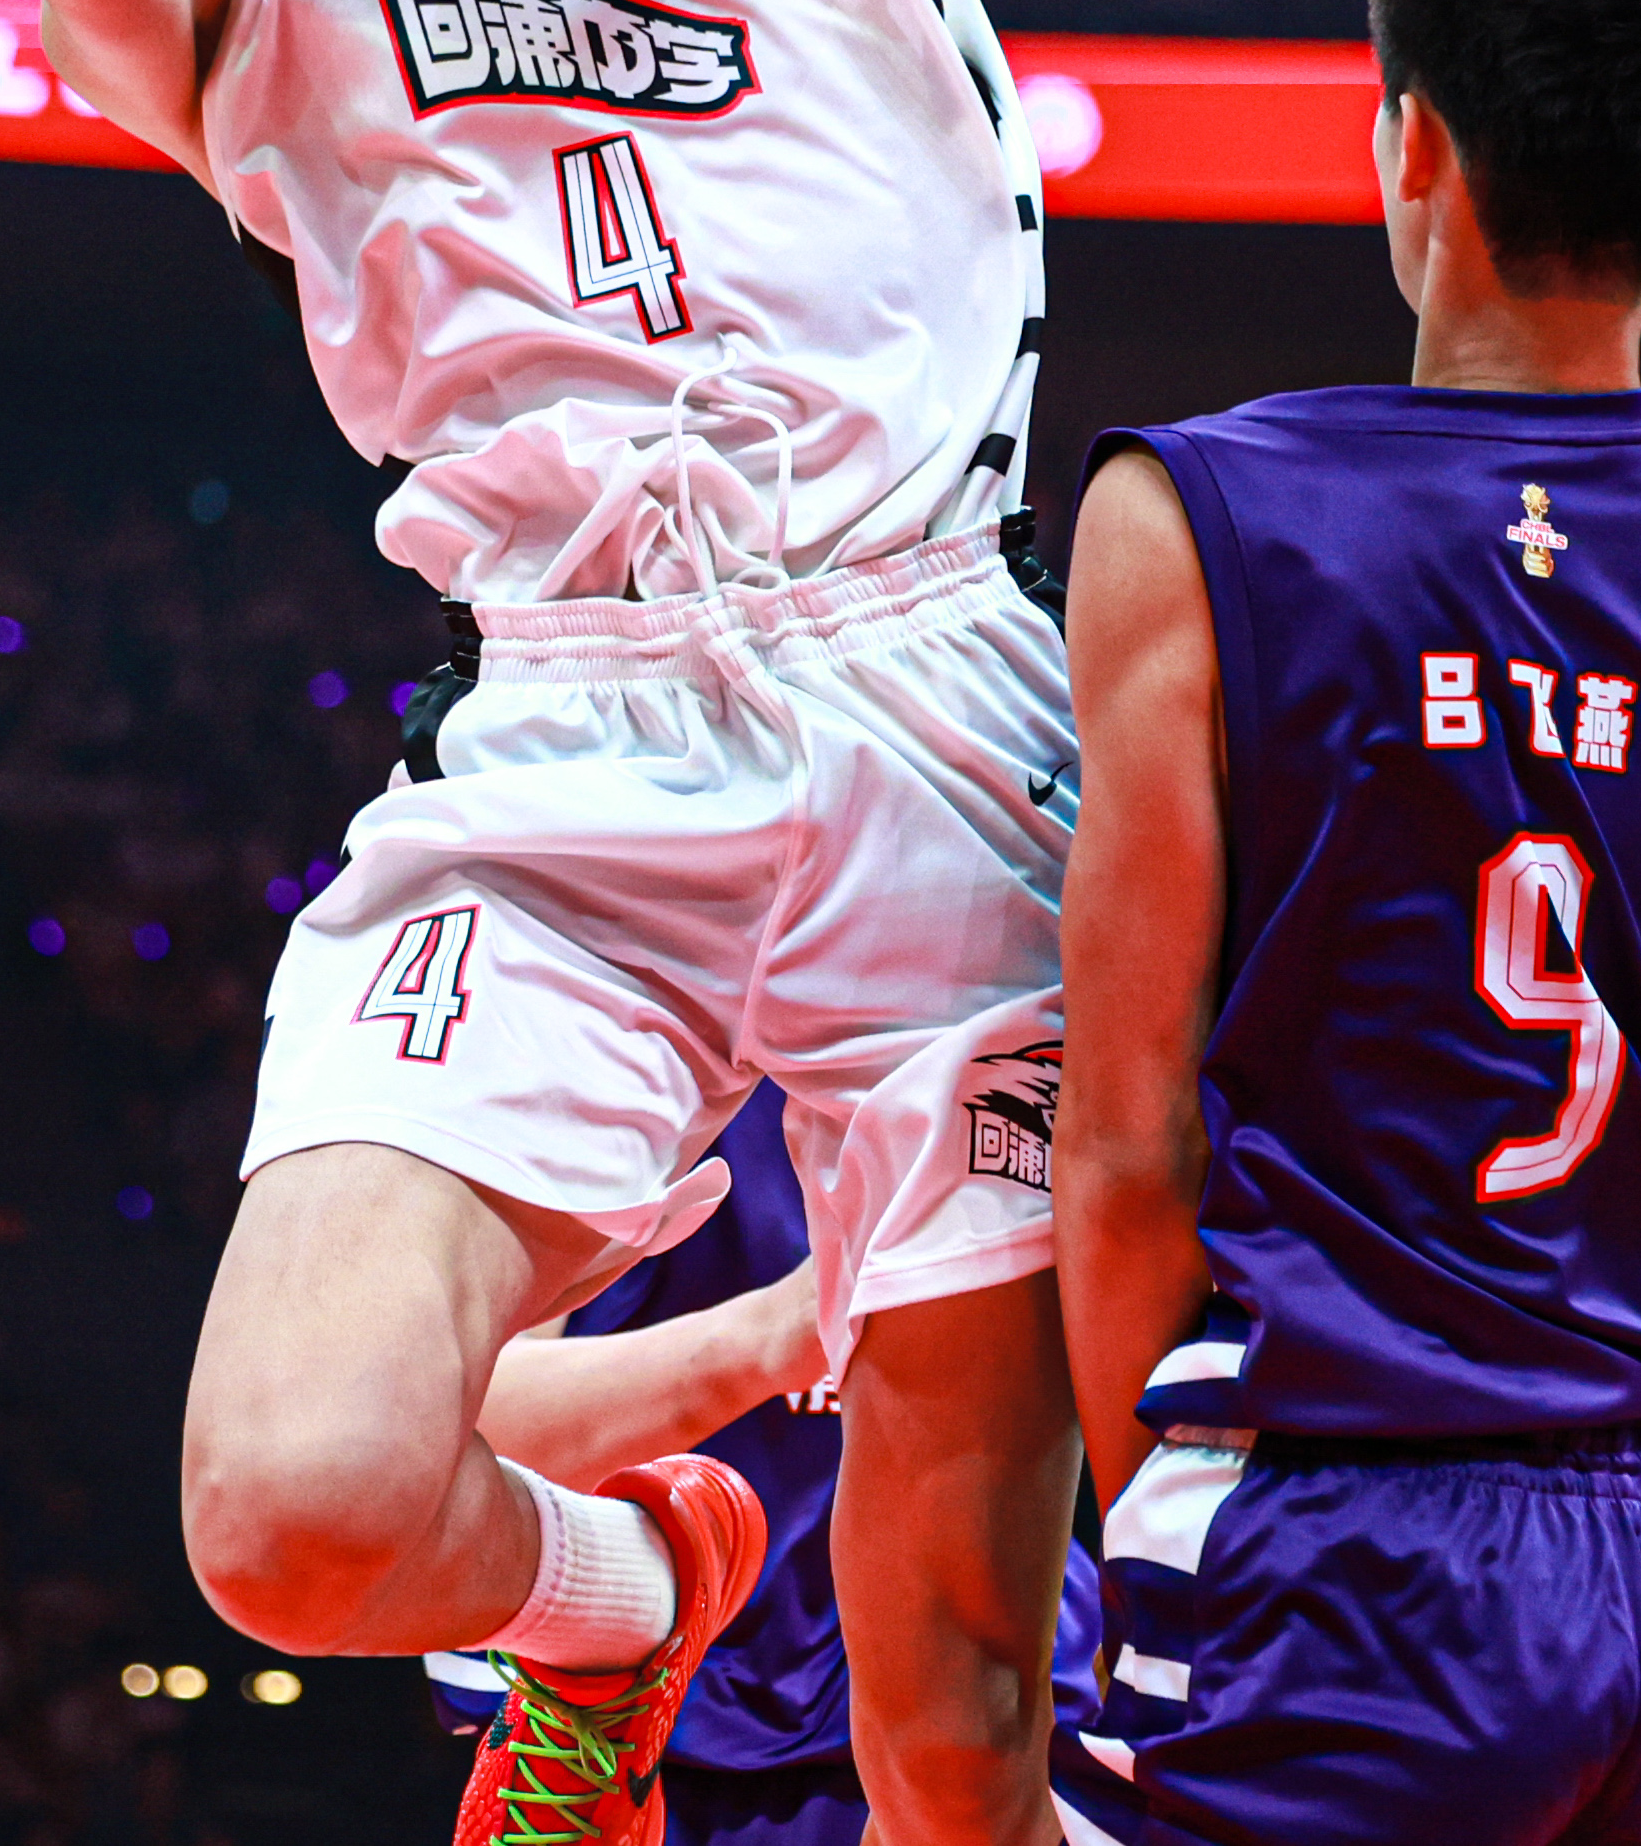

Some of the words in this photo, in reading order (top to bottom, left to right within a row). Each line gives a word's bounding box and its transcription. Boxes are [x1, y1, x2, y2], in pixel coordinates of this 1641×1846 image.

[553, 130, 694, 345] 4
[1509, 527, 1566, 548] FINALS
[1521, 520, 1554, 534] CHBL
[1420, 652, 1640, 773] 吕飞燕
[350, 903, 481, 1066] 4
[1473, 831, 1627, 1203] 9
[973, 1109, 1052, 1190] 回浦
